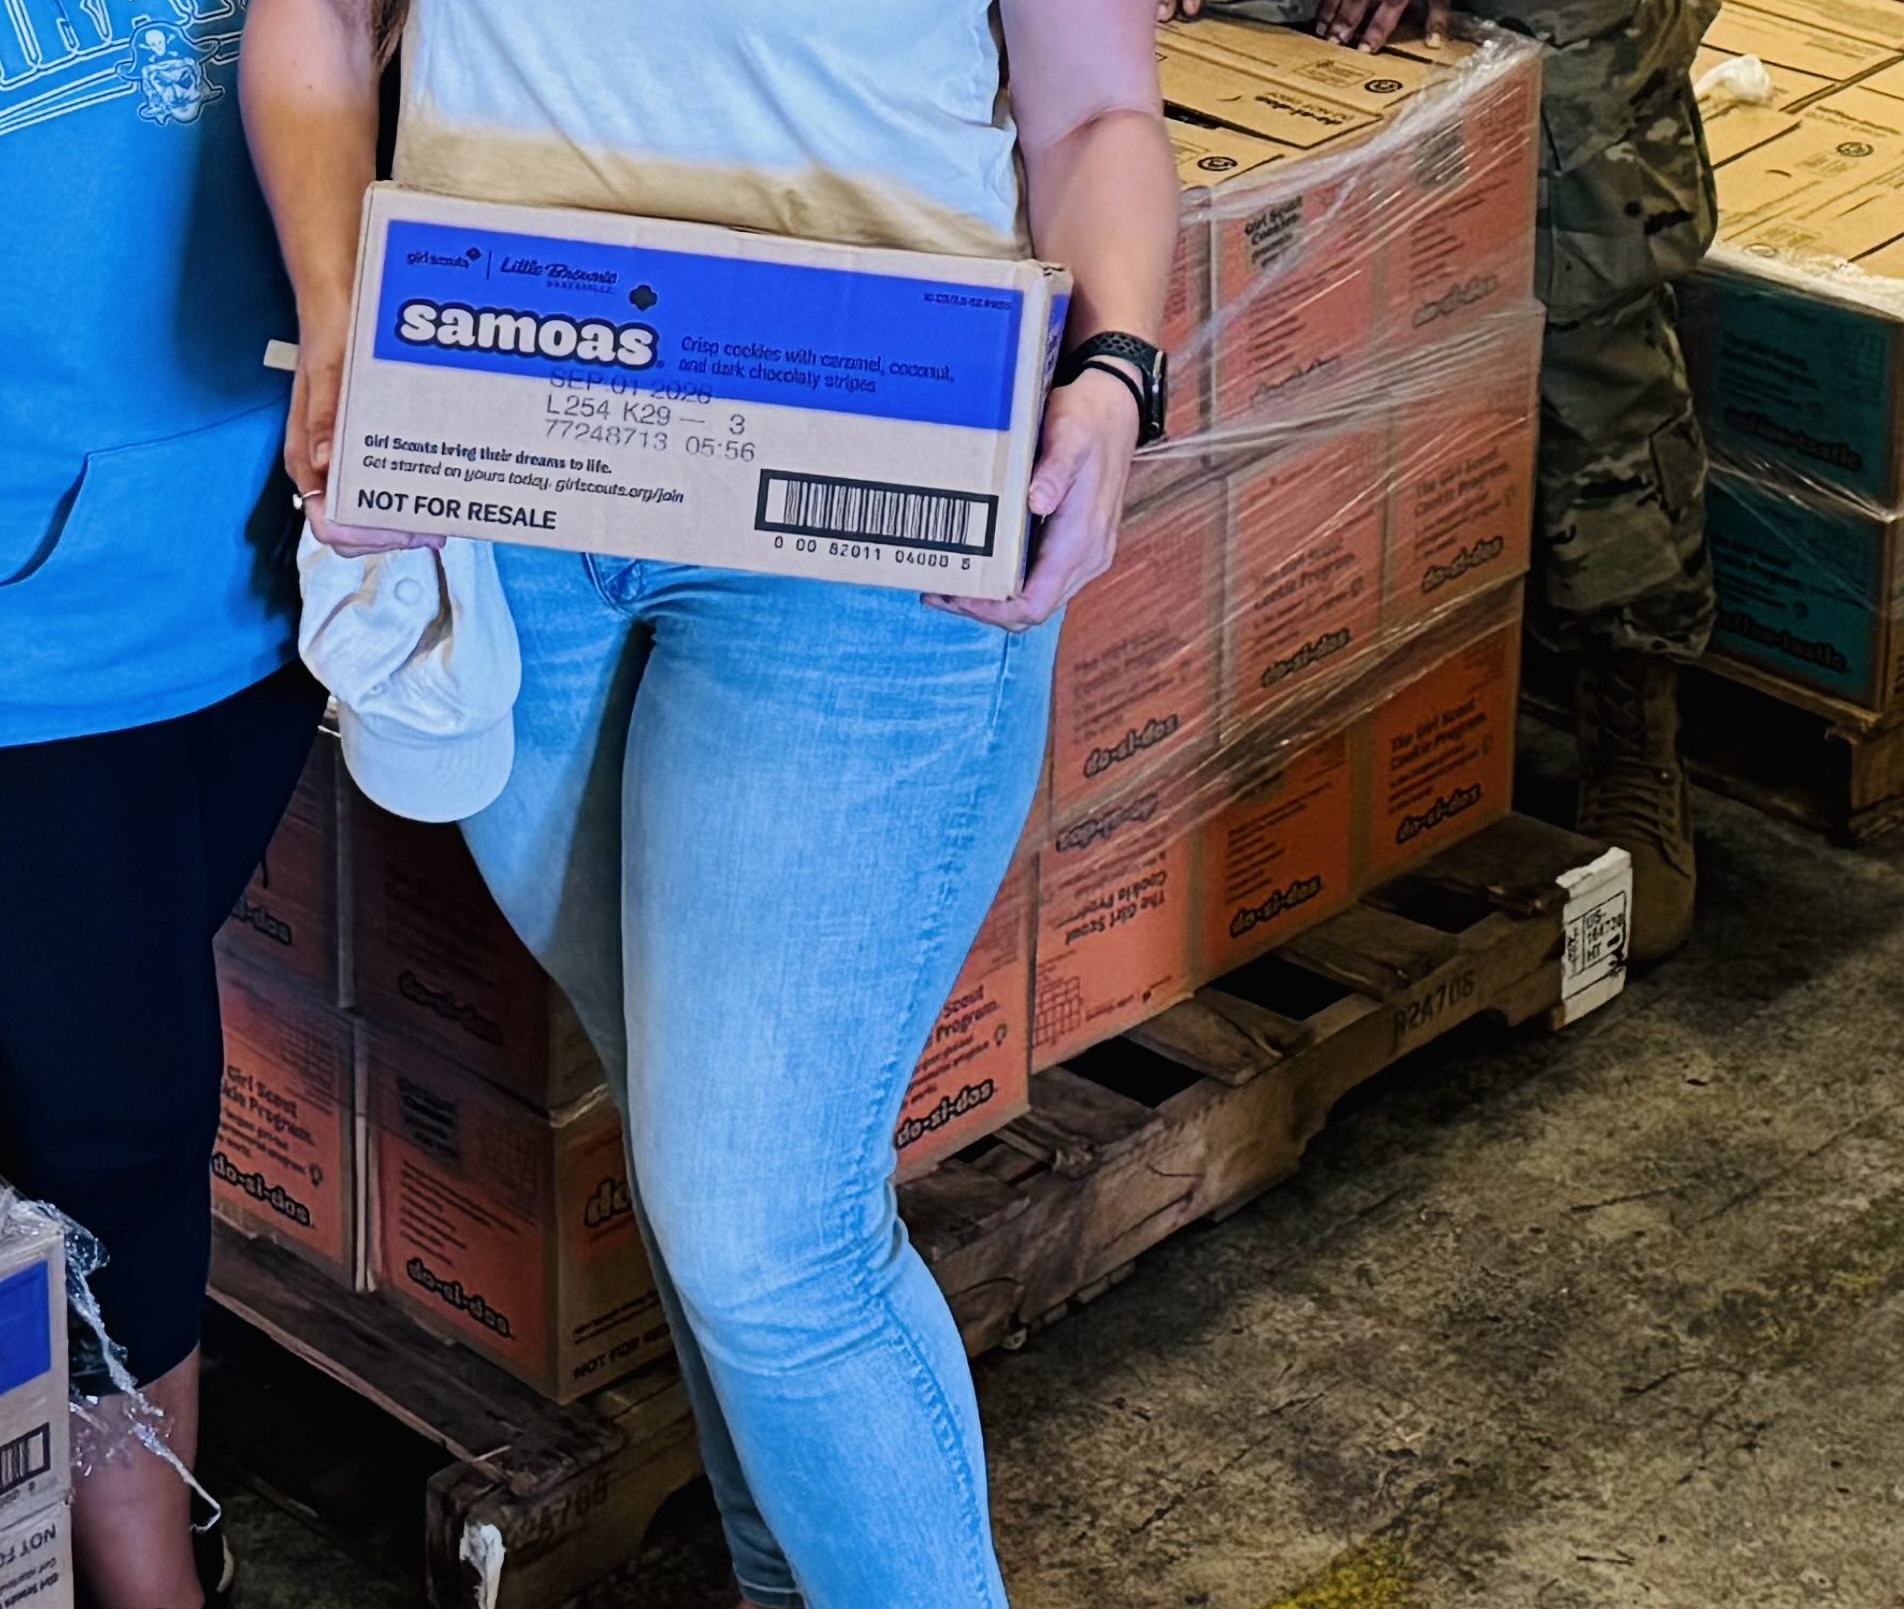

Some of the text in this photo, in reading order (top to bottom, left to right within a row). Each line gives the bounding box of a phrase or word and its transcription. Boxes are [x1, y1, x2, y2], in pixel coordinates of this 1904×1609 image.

[399, 300, 658, 368] samoas
[679, 359, 877, 393] and dark chocolaty stripes
[681, 336, 955, 383] Crisp cookies with caramel, coconut,
[549, 369, 712, 406] SEP 01 2026
[545, 418, 756, 463] 77248713 05:56
[623, 401, 672, 426] K29
[729, 414, 746, 435] 3
[364, 434, 612, 474] Girl Scouts bring their dreams to life.
[362, 455, 685, 504] Get started on yours today. girlscouts.org/join
[357, 489, 558, 530] NOT FOR RESALE
[774, 535, 784, 549] 0
[795, 538, 818, 553] 00
[829, 542, 882, 561] 82011
[895, 549, 950, 569] 04000
[1082, 713, 1180, 779] do-si-dos
[1396, 783, 1482, 845] do-si-dos
[1229, 875, 1322, 938] do-si-dos
[895, 1078, 994, 1151] do-si-dos
[211, 1152, 312, 1228] do-si-dos
[406, 1257, 510, 1338] do-si-dos
